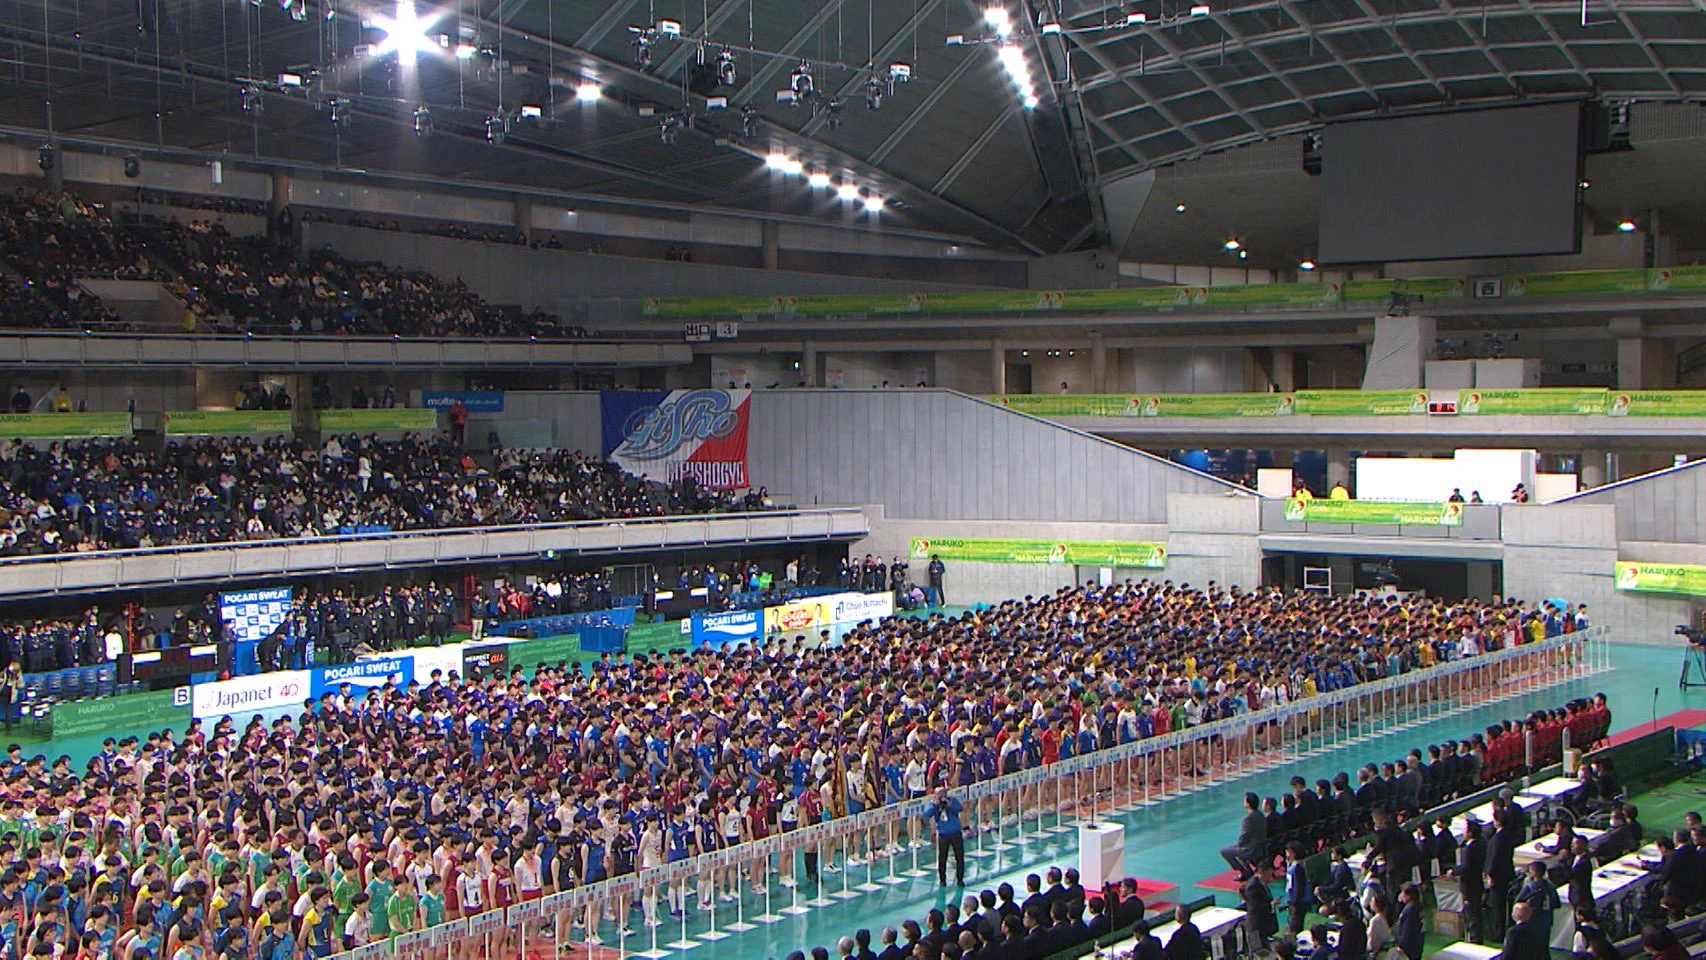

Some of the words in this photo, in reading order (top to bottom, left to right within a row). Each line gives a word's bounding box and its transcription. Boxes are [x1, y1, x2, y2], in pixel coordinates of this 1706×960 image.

[930, 539, 964, 548] HARUKO
[1640, 566, 1686, 576] HARUKO
[224, 592, 258, 604] POCARI
[258, 589, 289, 601] SWEAT
[703, 616, 731, 628] POCARI
[731, 612, 757, 624] SWEAT
[324, 667, 364, 681] POCARI
[366, 660, 402, 674] SWEAT
[177, 689, 189, 703] B
[216, 686, 272, 708] Japanet
[78, 703, 115, 714] HARUKO
